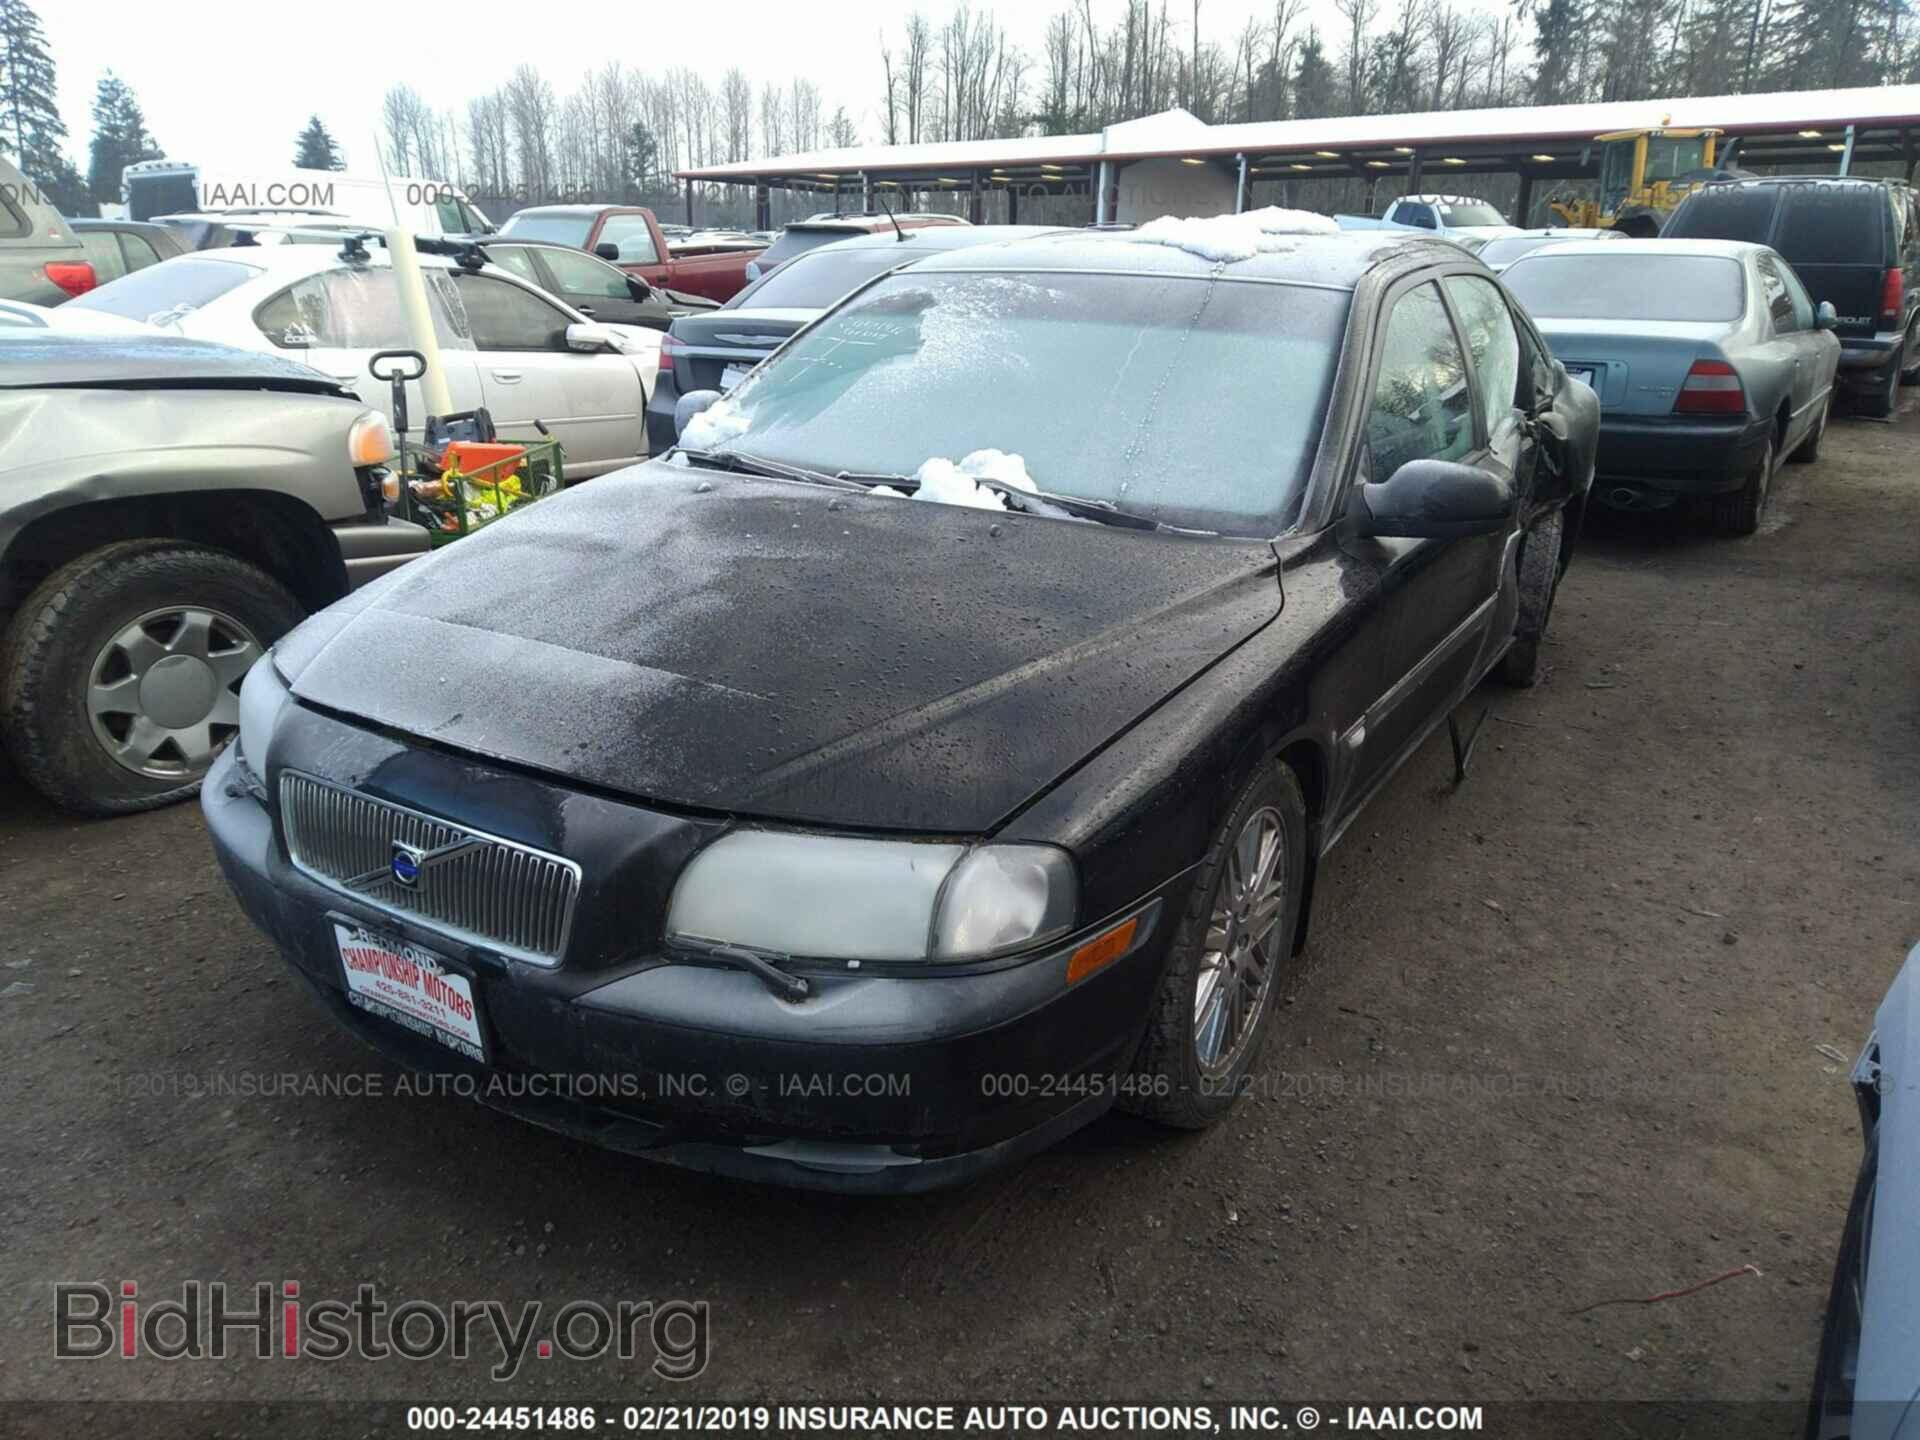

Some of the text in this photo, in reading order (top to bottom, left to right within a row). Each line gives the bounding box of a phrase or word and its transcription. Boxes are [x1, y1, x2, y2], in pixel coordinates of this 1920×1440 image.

[358, 927, 437, 971] REDMOND
[342, 948, 472, 1021] CHAMPIONSHIP MOTORS
